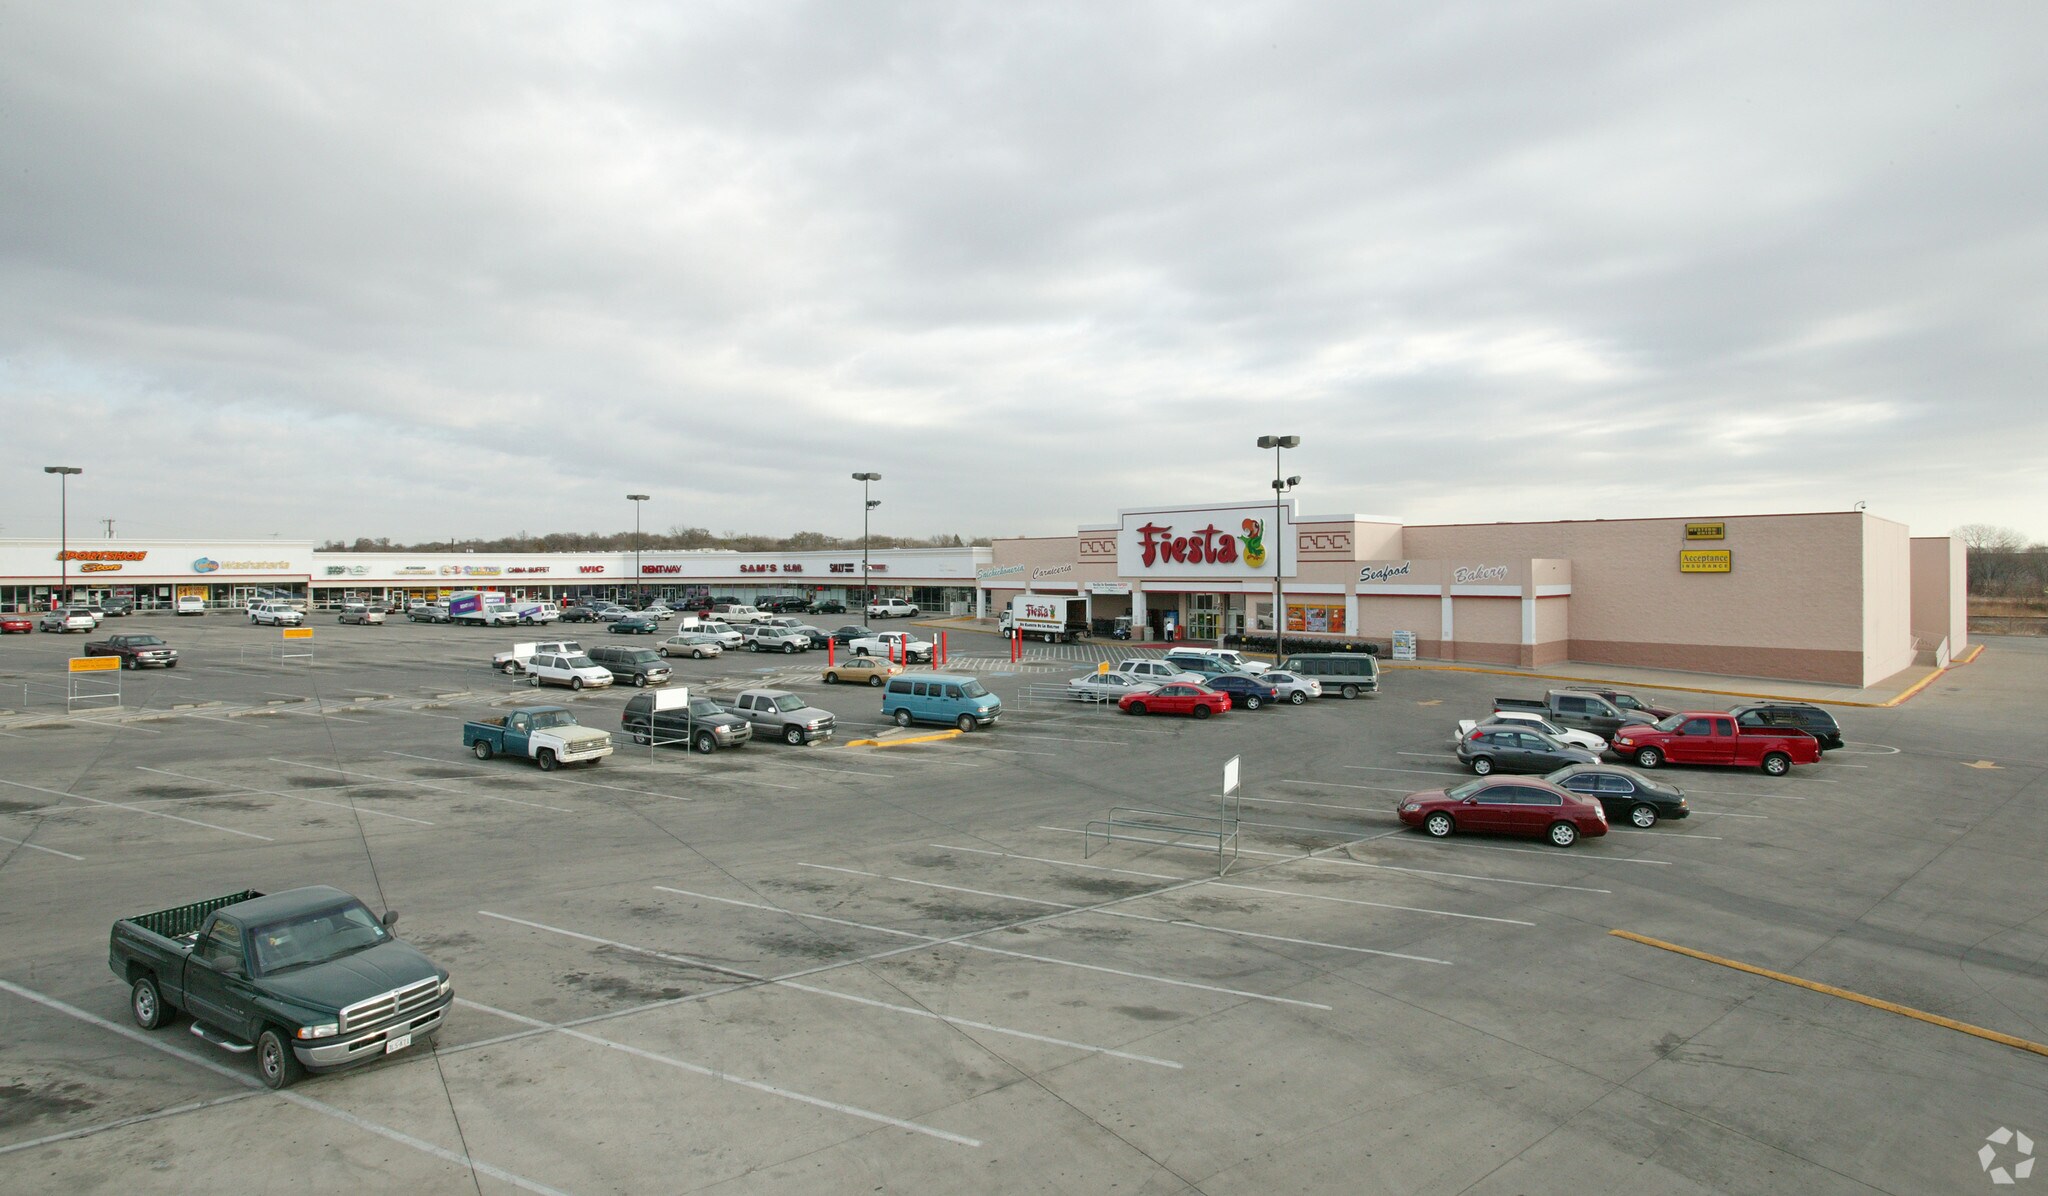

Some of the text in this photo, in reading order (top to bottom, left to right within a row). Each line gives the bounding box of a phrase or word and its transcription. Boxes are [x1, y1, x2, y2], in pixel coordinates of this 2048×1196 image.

[1136, 522, 1239, 568] Fiesta
[56, 551, 148, 561] SPORTSHOE
[1684, 555, 1728, 563] Acceptance
[642, 565, 682, 573] RENTWAY
[740, 564, 777, 572] SAM'S
[977, 563, 1025, 580] Salchichoneria
[1032, 564, 1072, 580] Carniceria
[1360, 562, 1410, 582] Seafood
[1455, 565, 1507, 582] Bakery
[1025, 604, 1048, 618] Fiesta
